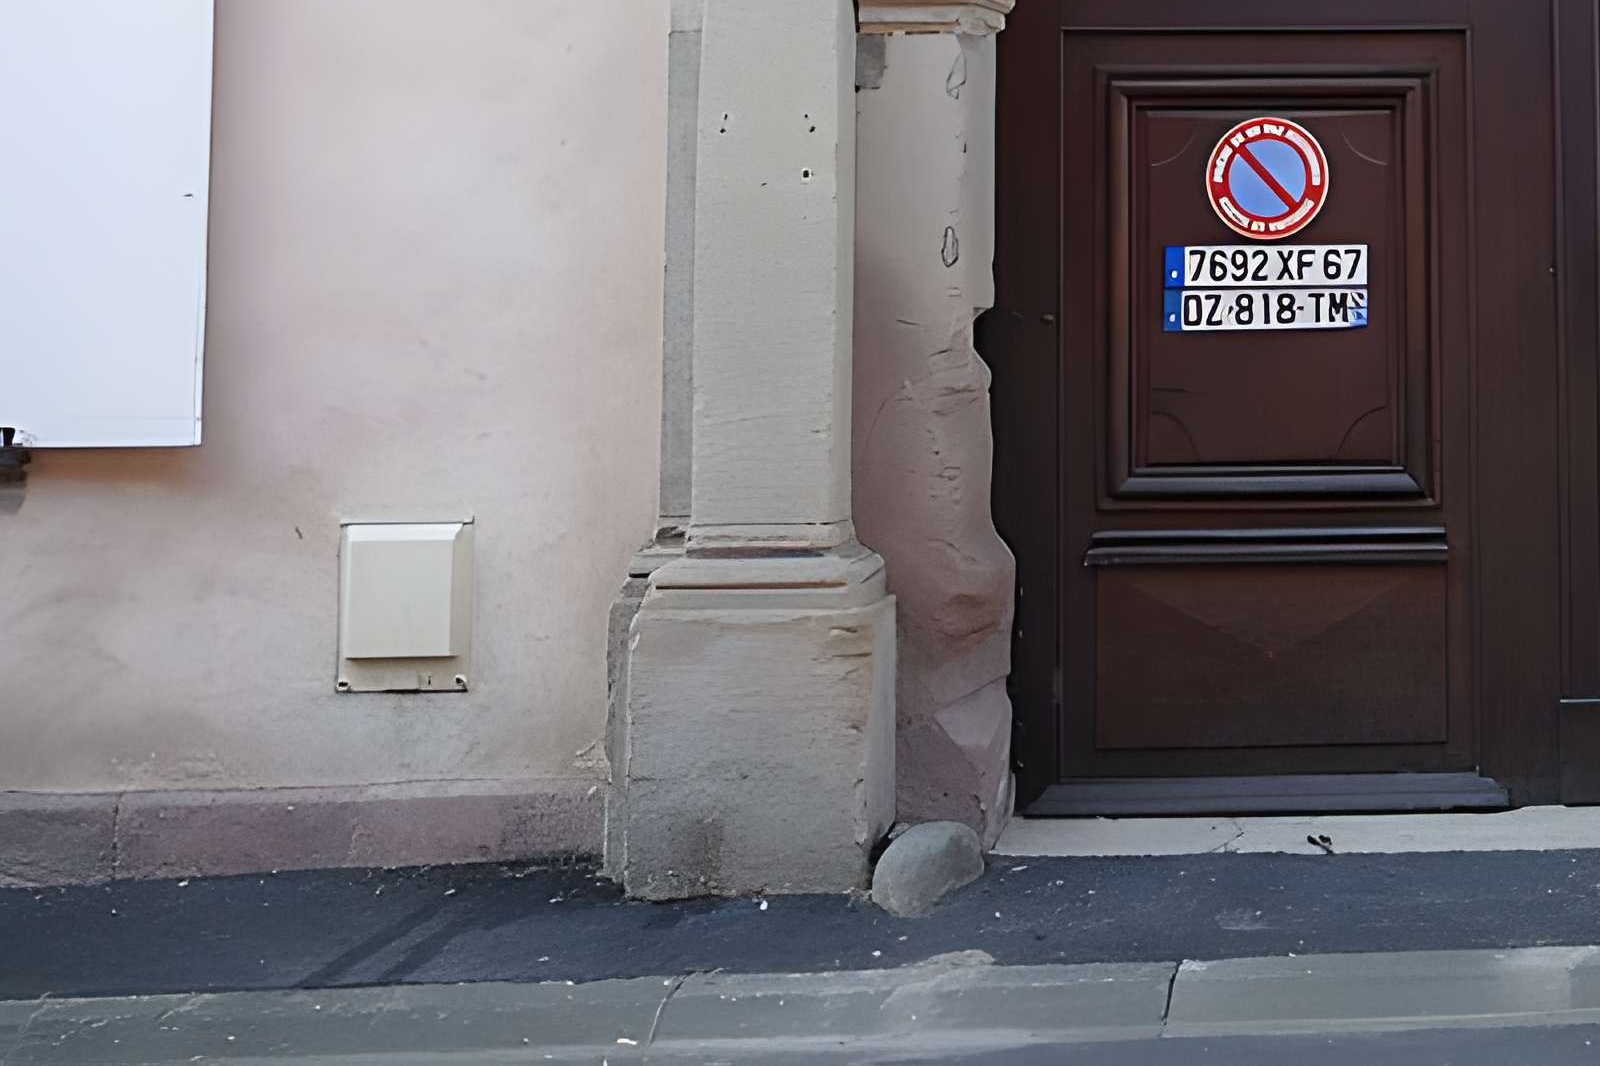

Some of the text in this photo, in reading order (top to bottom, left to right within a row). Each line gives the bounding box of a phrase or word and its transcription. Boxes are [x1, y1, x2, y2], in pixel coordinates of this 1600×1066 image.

[1189, 249, 1362, 281] 7692 XF 67
